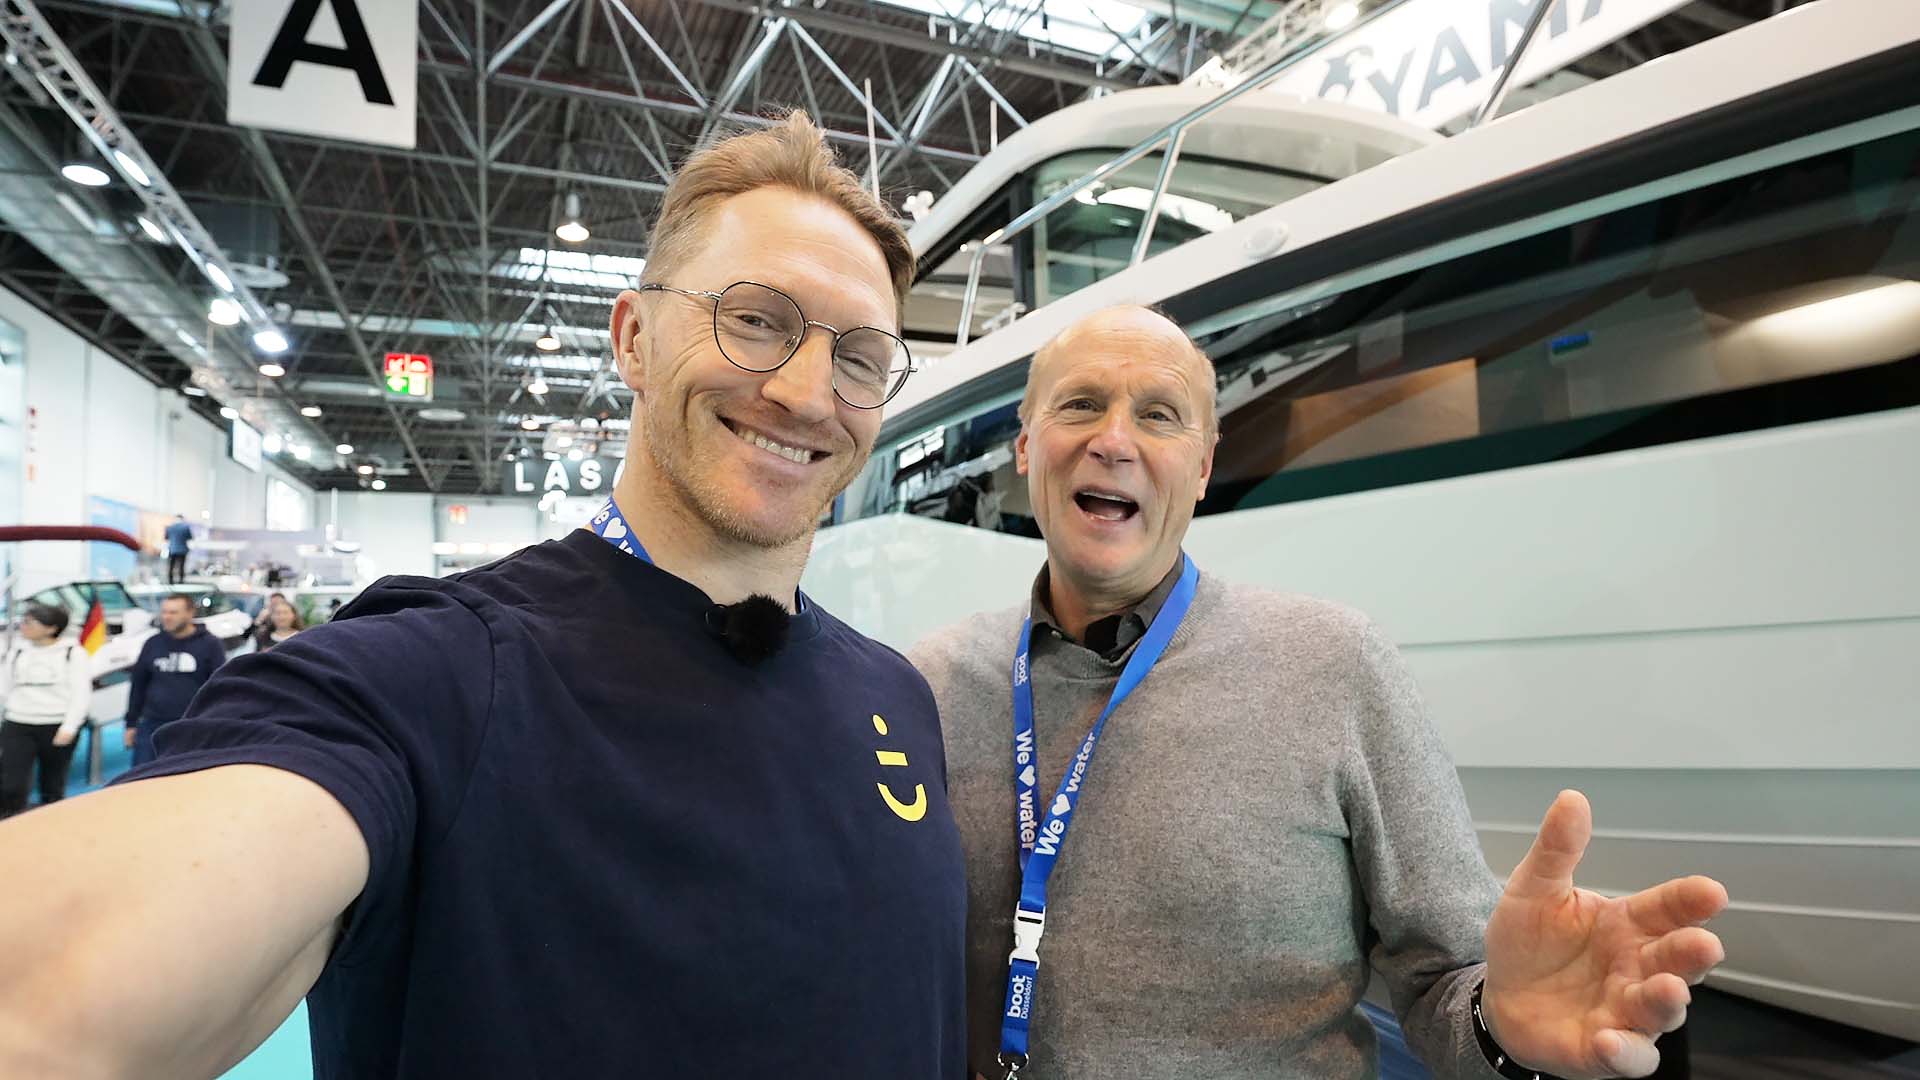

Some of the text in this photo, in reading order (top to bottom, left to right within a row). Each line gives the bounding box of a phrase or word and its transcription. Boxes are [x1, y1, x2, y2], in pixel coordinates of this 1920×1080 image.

[252, 0, 394, 106] A
[1367, 0, 1602, 116] YAM
[1016, 728, 1037, 849] We water
[1034, 732, 1096, 856] We water
[1006, 974, 1026, 1018] boot
